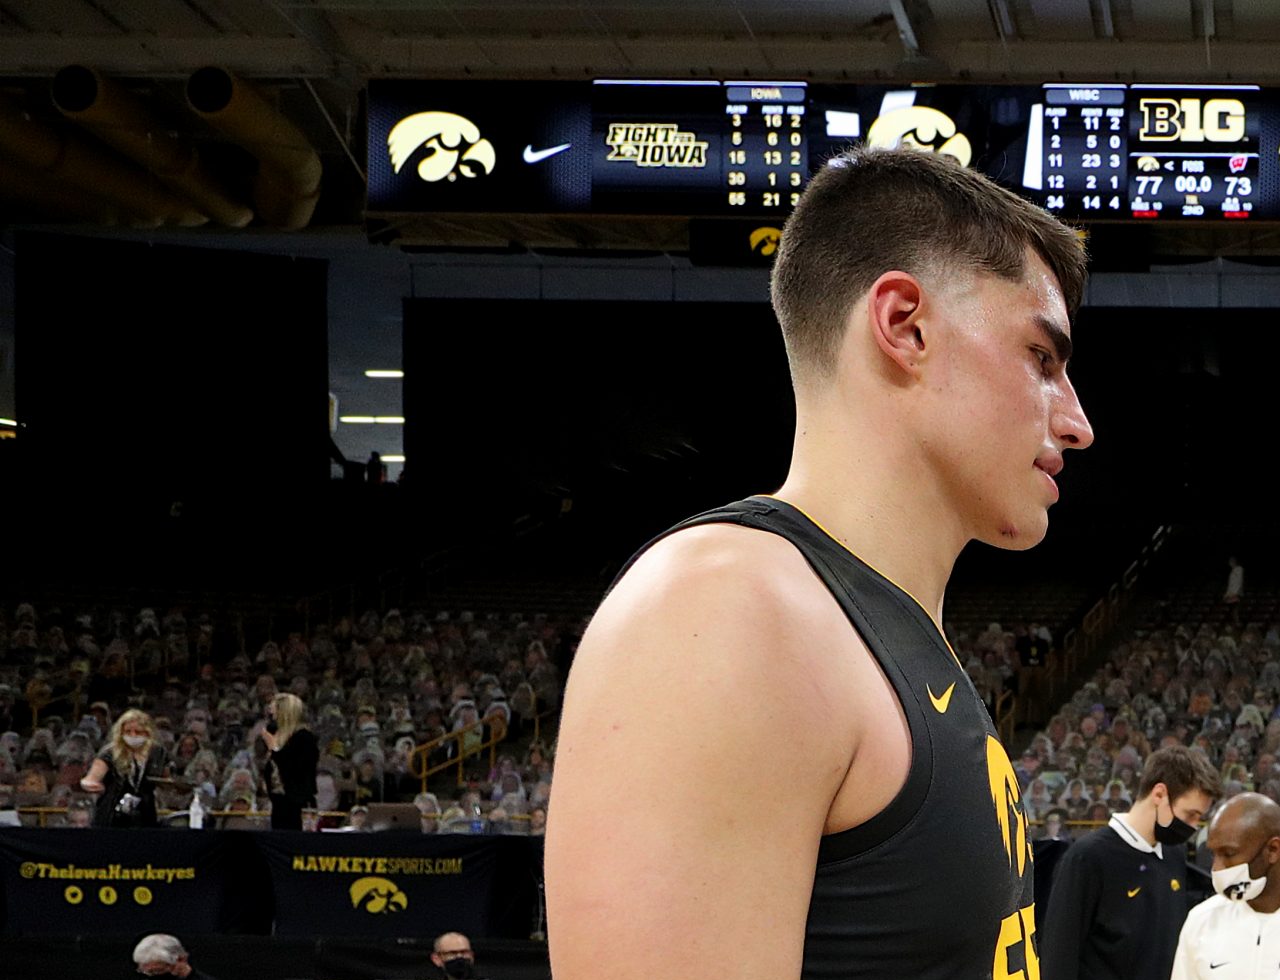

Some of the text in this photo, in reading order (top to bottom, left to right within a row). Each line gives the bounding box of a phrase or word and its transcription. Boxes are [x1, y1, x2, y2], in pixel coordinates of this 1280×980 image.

[732, 114, 801, 128] 3 16 2
[1051, 116, 1121, 130] 1 11 2
[610, 126, 676, 142] FIGHT
[790, 132, 801, 146] 0
[1051, 134, 1061, 149] 2
[1109, 134, 1121, 149] 0
[640, 144, 704, 163] IOWA
[764, 151, 782, 165] 13
[790, 151, 801, 166] 2
[1048, 153, 1121, 168] 11 23 3
[728, 171, 801, 187] 30 1 3
[1047, 174, 1119, 190] 12 2 1
[1136, 176, 1252, 196] 77 00.0 73
[763, 192, 780, 206] 21
[1047, 195, 1065, 209] 34
[1082, 195, 1101, 210] 14
[1109, 195, 1120, 210] 4
[20, 861, 196, 883] @TheIowaHawkeyes
[292, 856, 463, 875] HAWKEYESPORTS.COM
